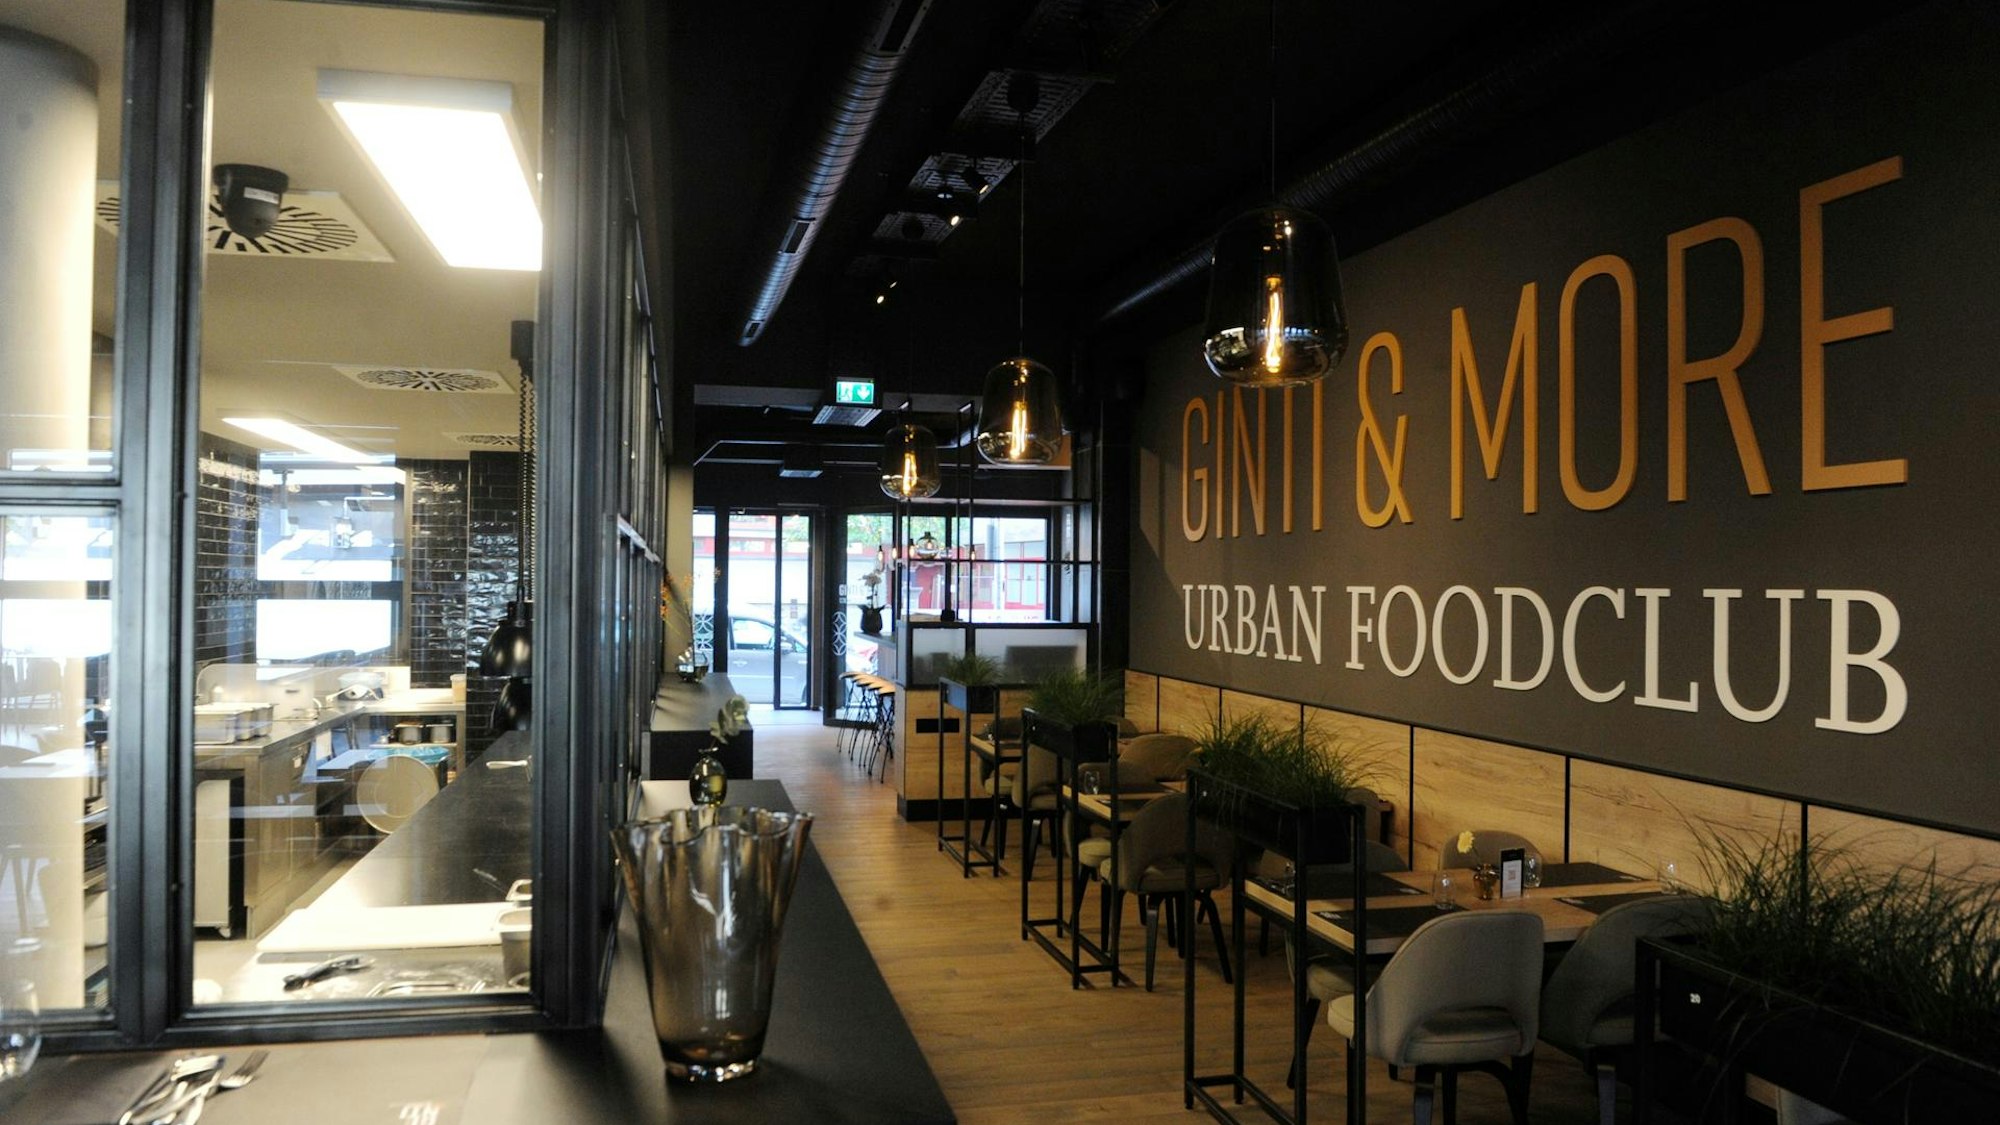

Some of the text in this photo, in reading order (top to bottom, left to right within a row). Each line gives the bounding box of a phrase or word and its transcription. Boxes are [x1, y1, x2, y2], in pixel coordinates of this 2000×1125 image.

[1356, 331, 1413, 528] &
[1450, 155, 1909, 520] MORE
[1182, 584, 1909, 735] URBAN FOODCLUB
